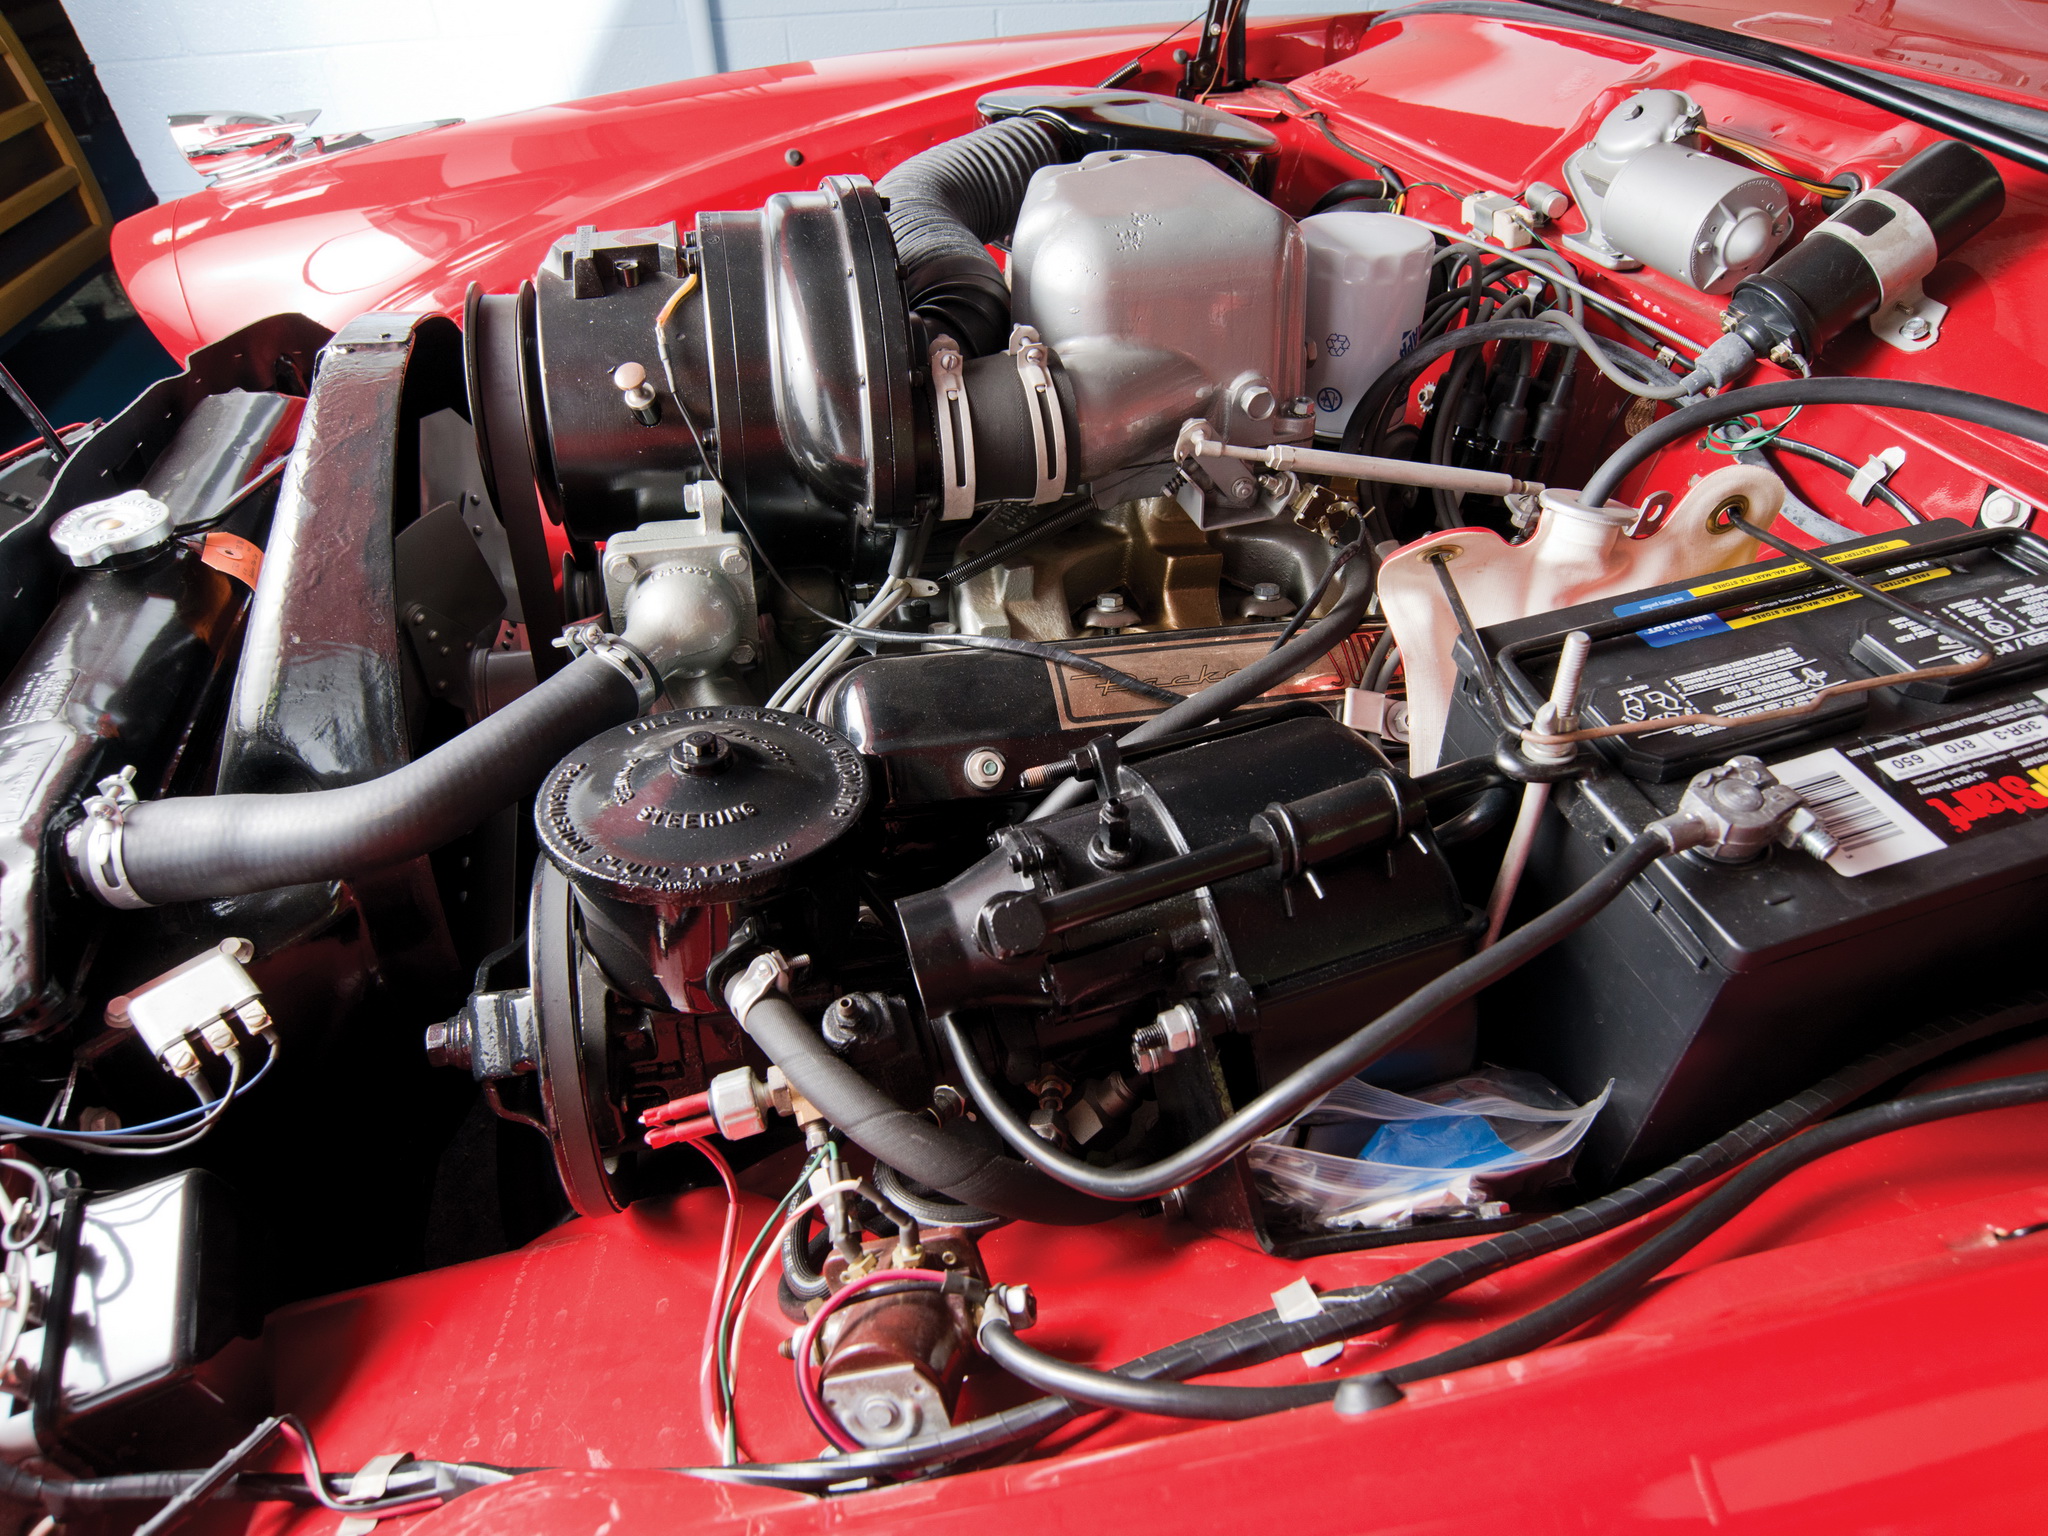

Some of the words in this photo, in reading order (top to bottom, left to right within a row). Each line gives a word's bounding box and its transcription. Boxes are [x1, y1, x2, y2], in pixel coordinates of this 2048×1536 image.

[1667, 629, 1678, 637] to
[1677, 623, 1703, 635] Return
[687, 709, 714, 721] TO
[724, 709, 791, 726] LEVEL
[627, 716, 680, 735] FILL
[795, 721, 838, 745] WITH
[1990, 720, 2044, 740] 36R-3
[1941, 739, 1978, 754] 810
[1888, 753, 1927, 769] 650
[827, 746, 864, 818] AUTOMATIC
[1912, 780, 1953, 795] Battery
[613, 757, 640, 807] POWER
[637, 802, 758, 829] STEERING
[547, 763, 593, 854] TRANSMISSION
[593, 854, 670, 877] FLUID
[683, 862, 752, 880] TYPE
